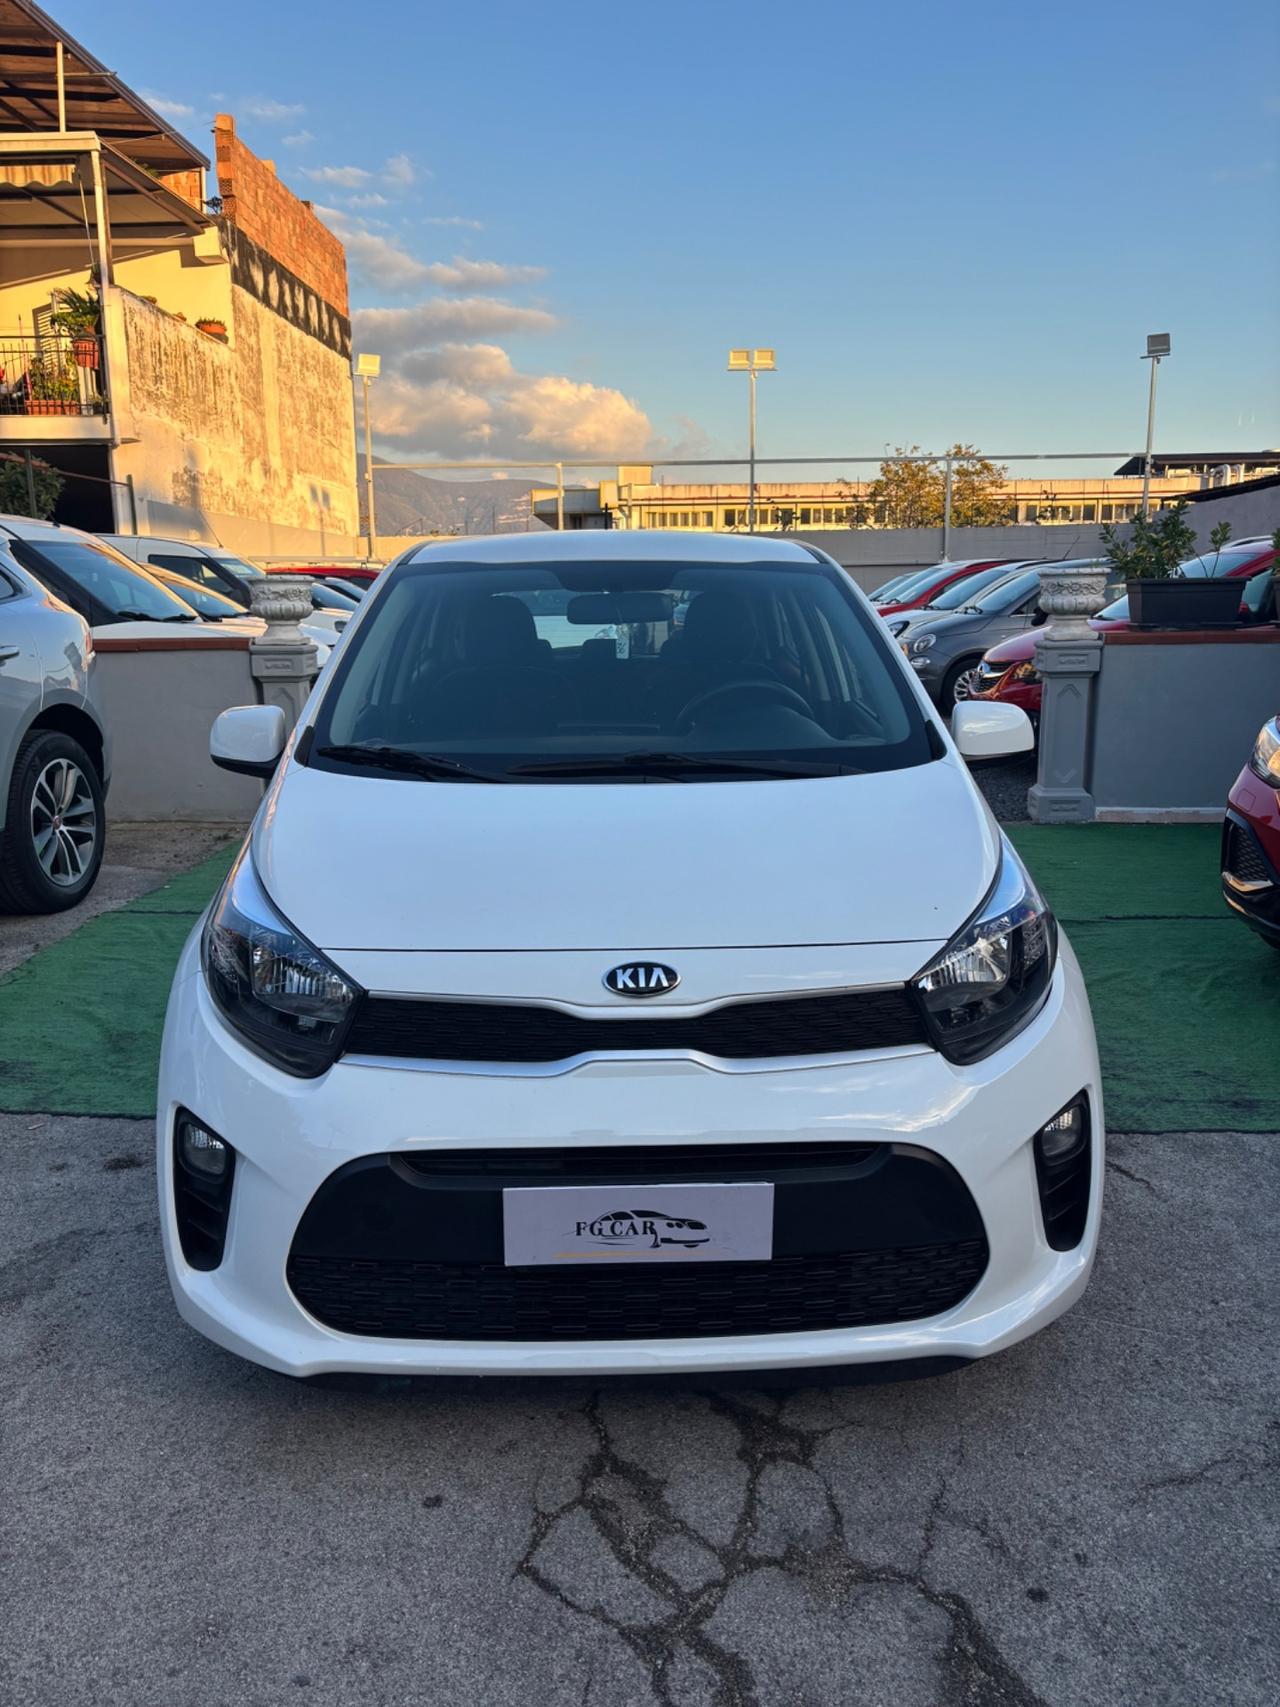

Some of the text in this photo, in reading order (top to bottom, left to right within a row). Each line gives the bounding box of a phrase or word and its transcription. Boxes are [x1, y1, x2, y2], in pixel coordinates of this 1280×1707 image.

[616, 967, 669, 989] KIA
[575, 1220, 657, 1237] FG CAR
